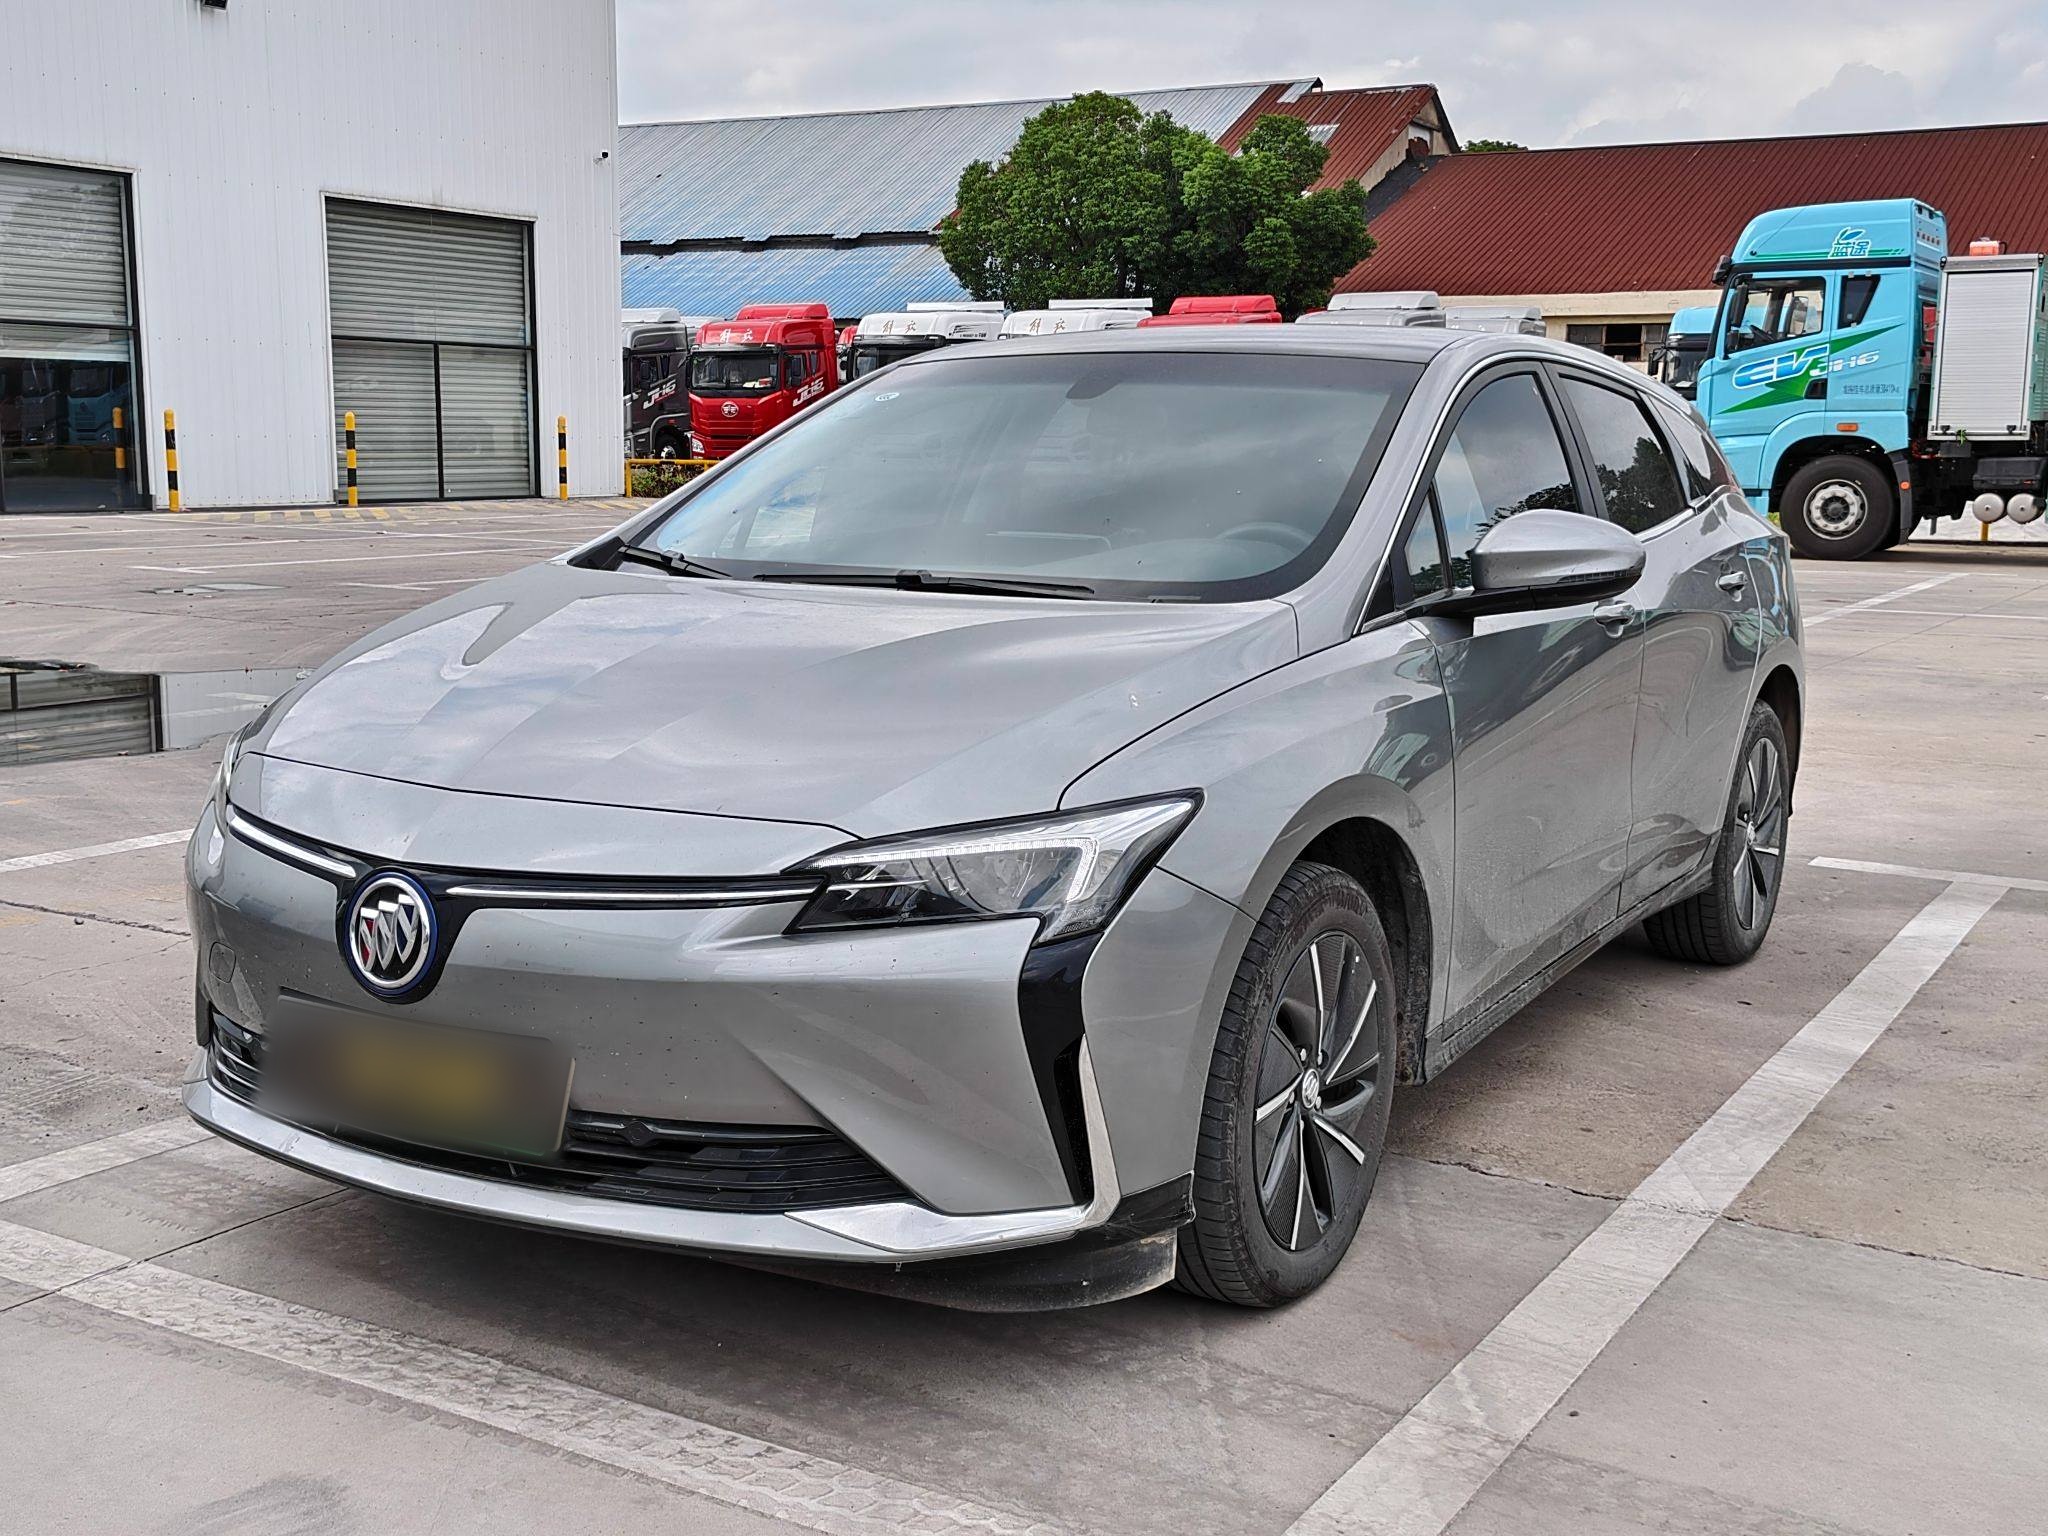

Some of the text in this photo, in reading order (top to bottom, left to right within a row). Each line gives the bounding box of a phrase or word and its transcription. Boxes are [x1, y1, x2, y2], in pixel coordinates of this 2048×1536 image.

[1829, 234, 1871, 258] 蓝途
[1732, 343, 1880, 389] EV JH6
